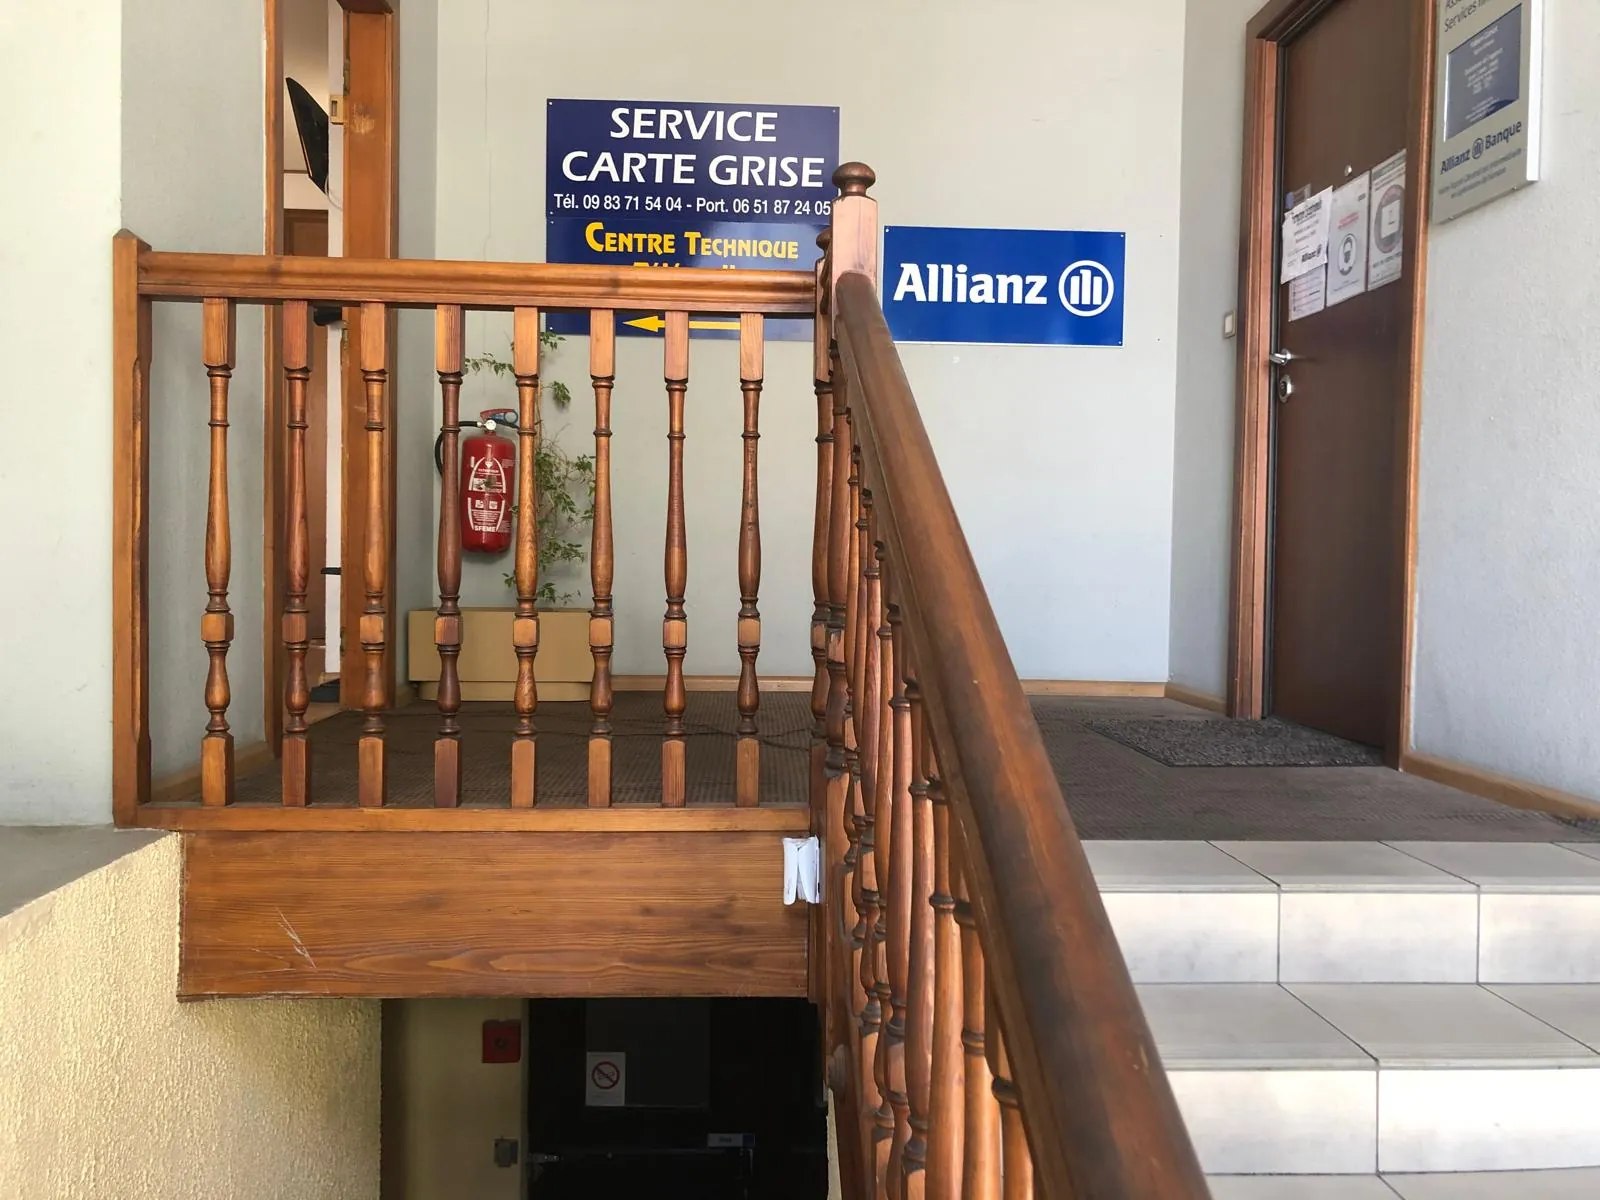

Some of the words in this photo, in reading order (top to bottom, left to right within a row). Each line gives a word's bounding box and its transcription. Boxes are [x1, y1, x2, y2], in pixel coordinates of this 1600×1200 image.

[1444, 1, 1477, 32] Services
[610, 107, 778, 142] SERVICE
[1440, 149, 1470, 175] Allianz
[1485, 121, 1522, 150] Banque
[562, 150, 697, 184] CARTE
[708, 154, 825, 187] GRISE
[553, 193, 578, 209] Tél.
[583, 195, 600, 209] 09
[603, 195, 620, 210] 83
[625, 196, 640, 210] 71
[645, 196, 662, 211] 54
[665, 197, 682, 211] 04
[696, 197, 728, 213] Port.
[733, 198, 749, 213] 06
[753, 199, 768, 213] 51
[774, 199, 790, 214] 87
[794, 200, 810, 215] 24
[814, 200, 830, 216] 05
[585, 222, 675, 256] CENTRE
[684, 231, 799, 259] TECHNIQUE
[893, 263, 1047, 305] Allianz
